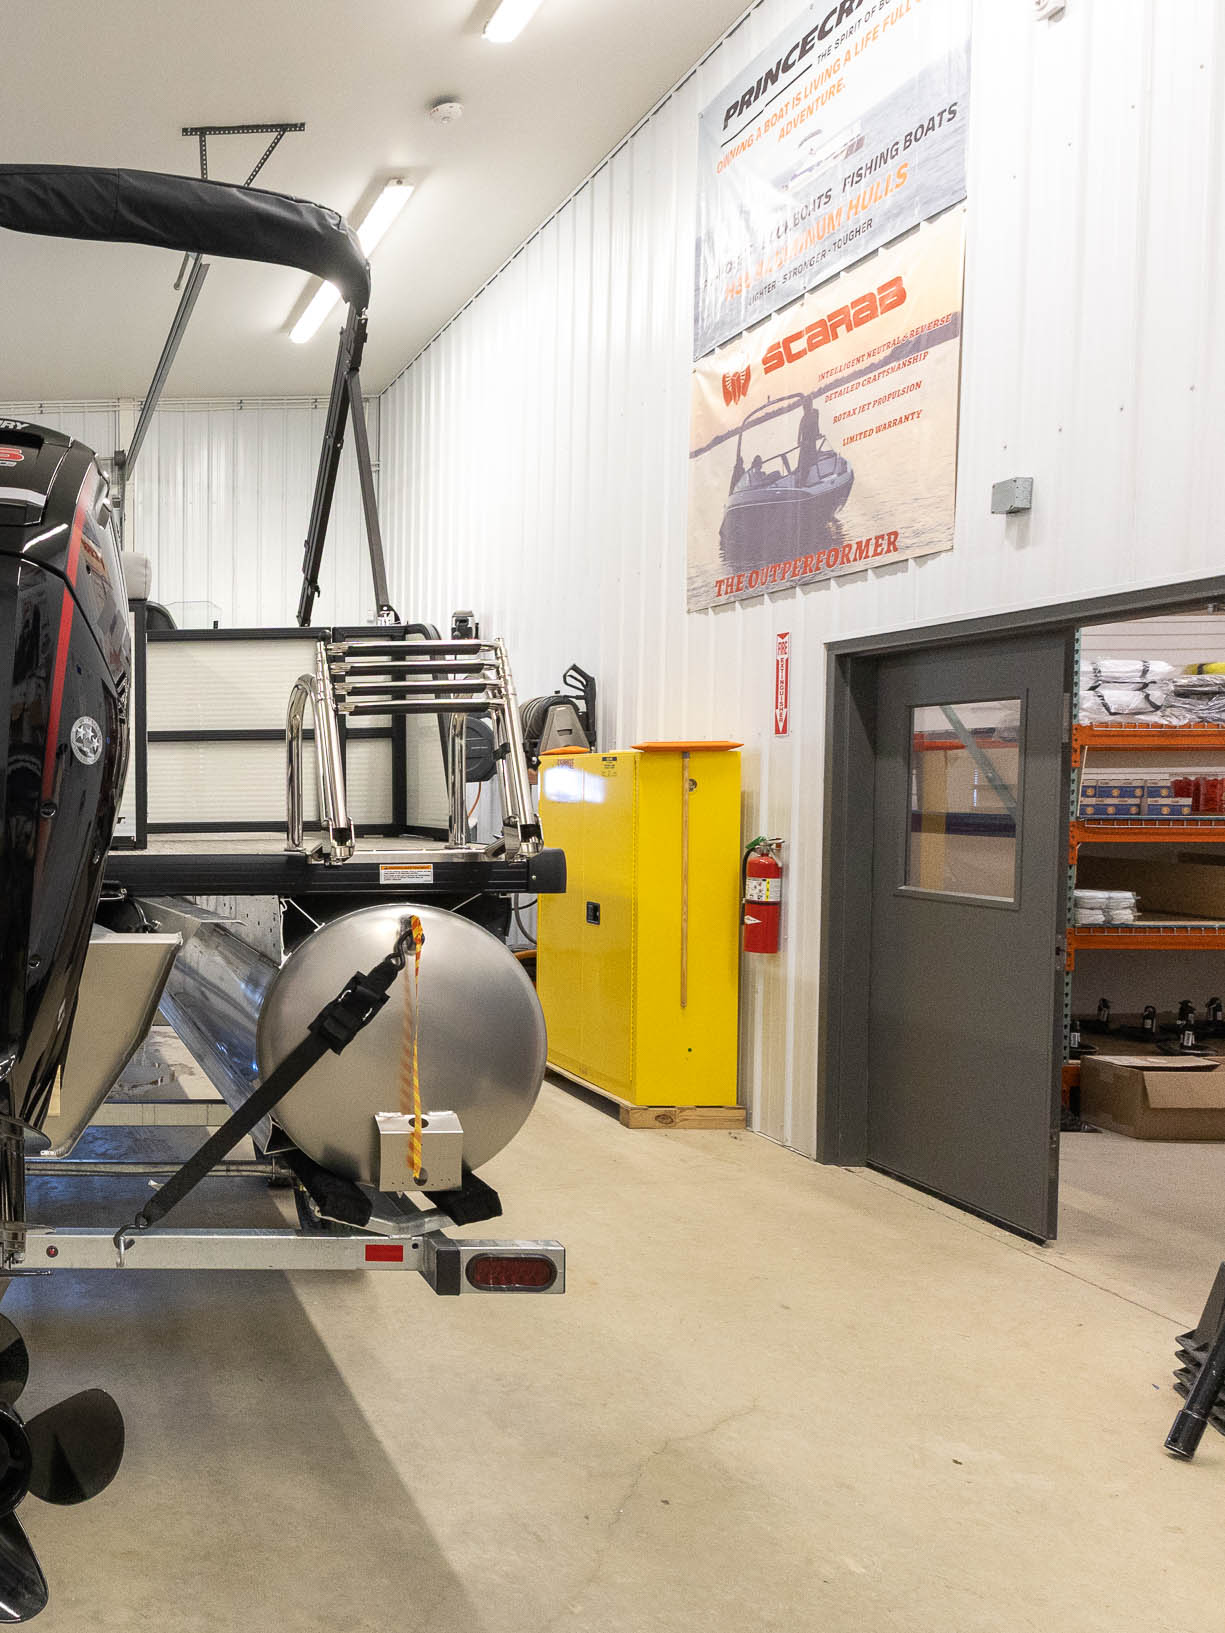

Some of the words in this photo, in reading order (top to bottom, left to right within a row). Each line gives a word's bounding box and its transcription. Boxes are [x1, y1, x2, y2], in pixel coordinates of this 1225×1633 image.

[722, 0, 863, 131] PRINCECR
[817, 45, 832, 64] THE
[834, 18, 862, 50] SPIRIT
[864, 5, 877, 23] OF
[716, 133, 754, 174] OWNING
[756, 126, 762, 141] A
[764, 101, 790, 134] BOAT
[792, 91, 802, 111] IS
[804, 58, 841, 99] LIVING
[843, 49, 852, 66] A
[854, 24, 881, 57] LIFE
[882, 0, 911, 33] FULL
[842, 141, 899, 193] FISHING
[903, 102, 958, 151] BOATS
[847, 162, 908, 222] HULLS
[782, 249, 826, 284] STRONGER
[833, 218, 873, 252] TOUGHER
[818, 353, 865, 382] INTELLIGENT
[866, 336, 901, 360] NEUTRAL
[910, 313, 952, 339] REVERSE
[824, 381, 861, 403] DETAILED
[861, 351, 929, 387] CRAFTSMANSHIP
[833, 407, 858, 424] ROTAX
[858, 401, 872, 416] JET
[872, 380, 923, 408] PROPULSION
[842, 428, 874, 447] LIMITED
[874, 409, 923, 434] WARRANTY
[715, 573, 745, 598] THE
[748, 530, 899, 589] OUTPERFORMER
